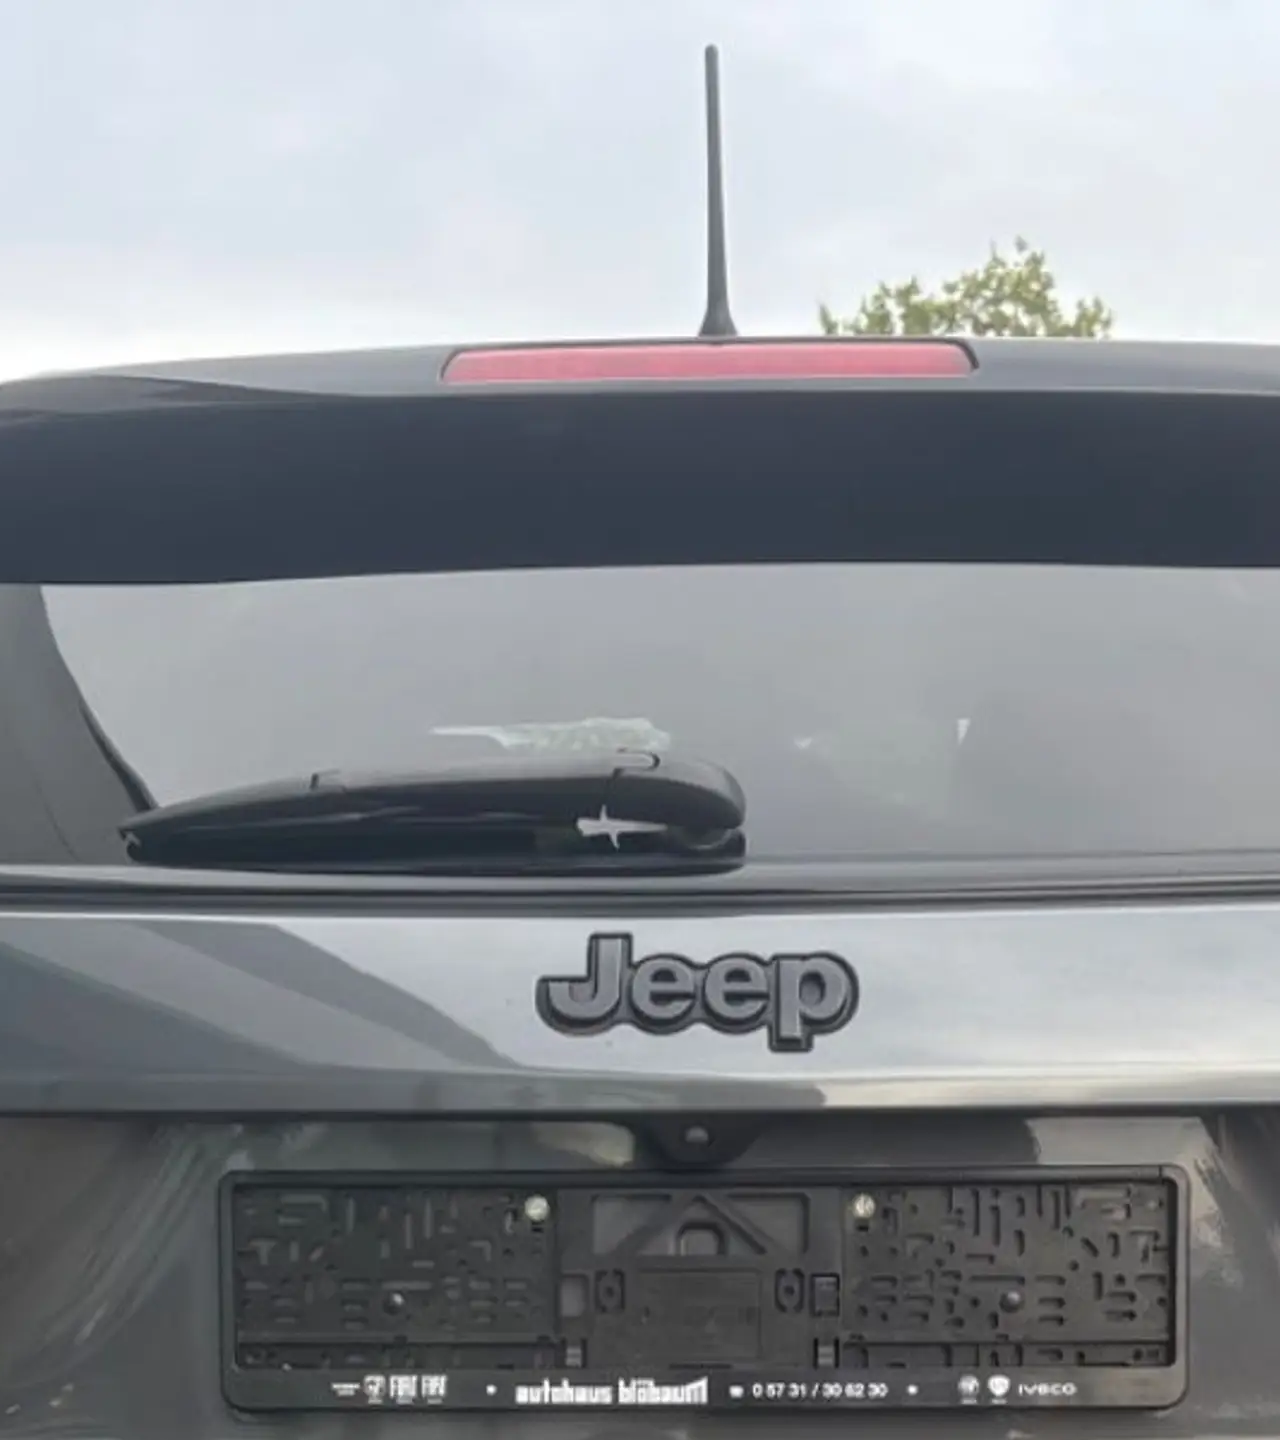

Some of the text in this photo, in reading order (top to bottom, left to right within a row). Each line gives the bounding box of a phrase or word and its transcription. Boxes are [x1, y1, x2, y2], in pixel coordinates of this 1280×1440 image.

[535, 931, 859, 1053] Jeep
[515, 1377, 613, 1404] autohaus
[1018, 1382, 1077, 1396] IVECO
